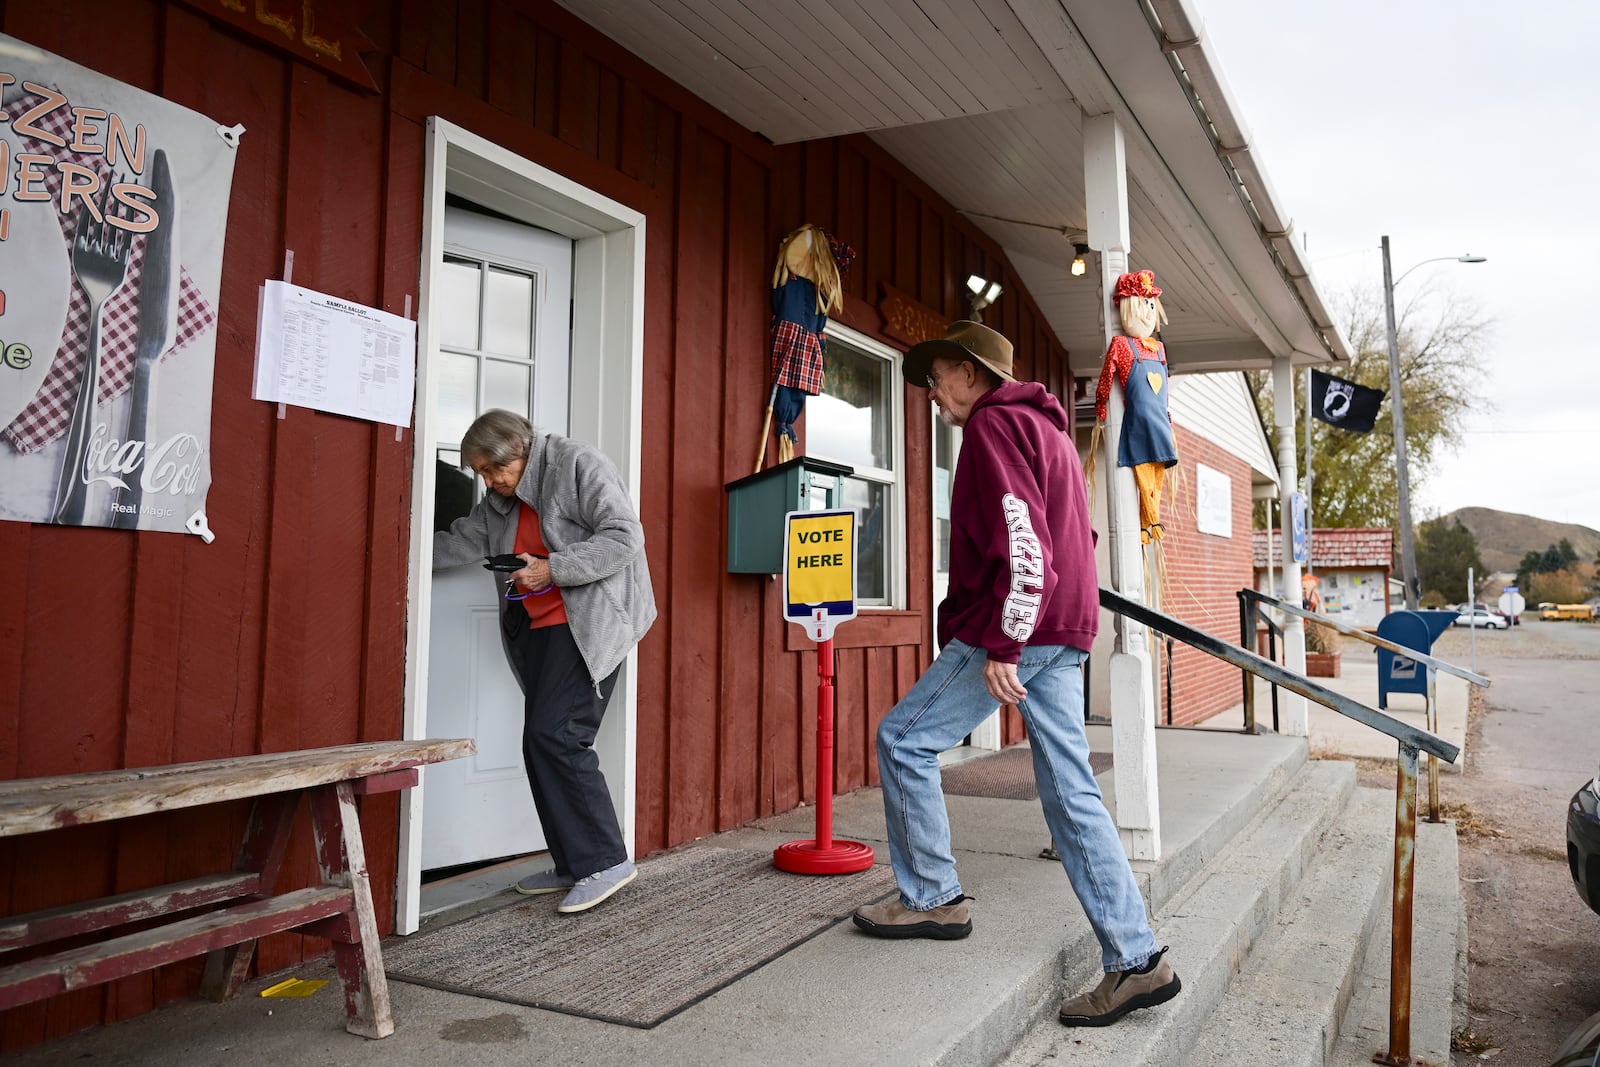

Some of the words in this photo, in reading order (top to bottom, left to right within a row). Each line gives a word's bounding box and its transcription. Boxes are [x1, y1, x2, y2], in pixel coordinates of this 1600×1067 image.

[326, 300, 347, 310] SAMPLE
[347, 305, 366, 315] BALLOT
[111, 502, 137, 514] Real
[140, 504, 174, 517] Magic
[797, 529, 844, 544] VOTE
[797, 553, 844, 568] HERE
[1001, 492, 1045, 643] GRIZZLIES
